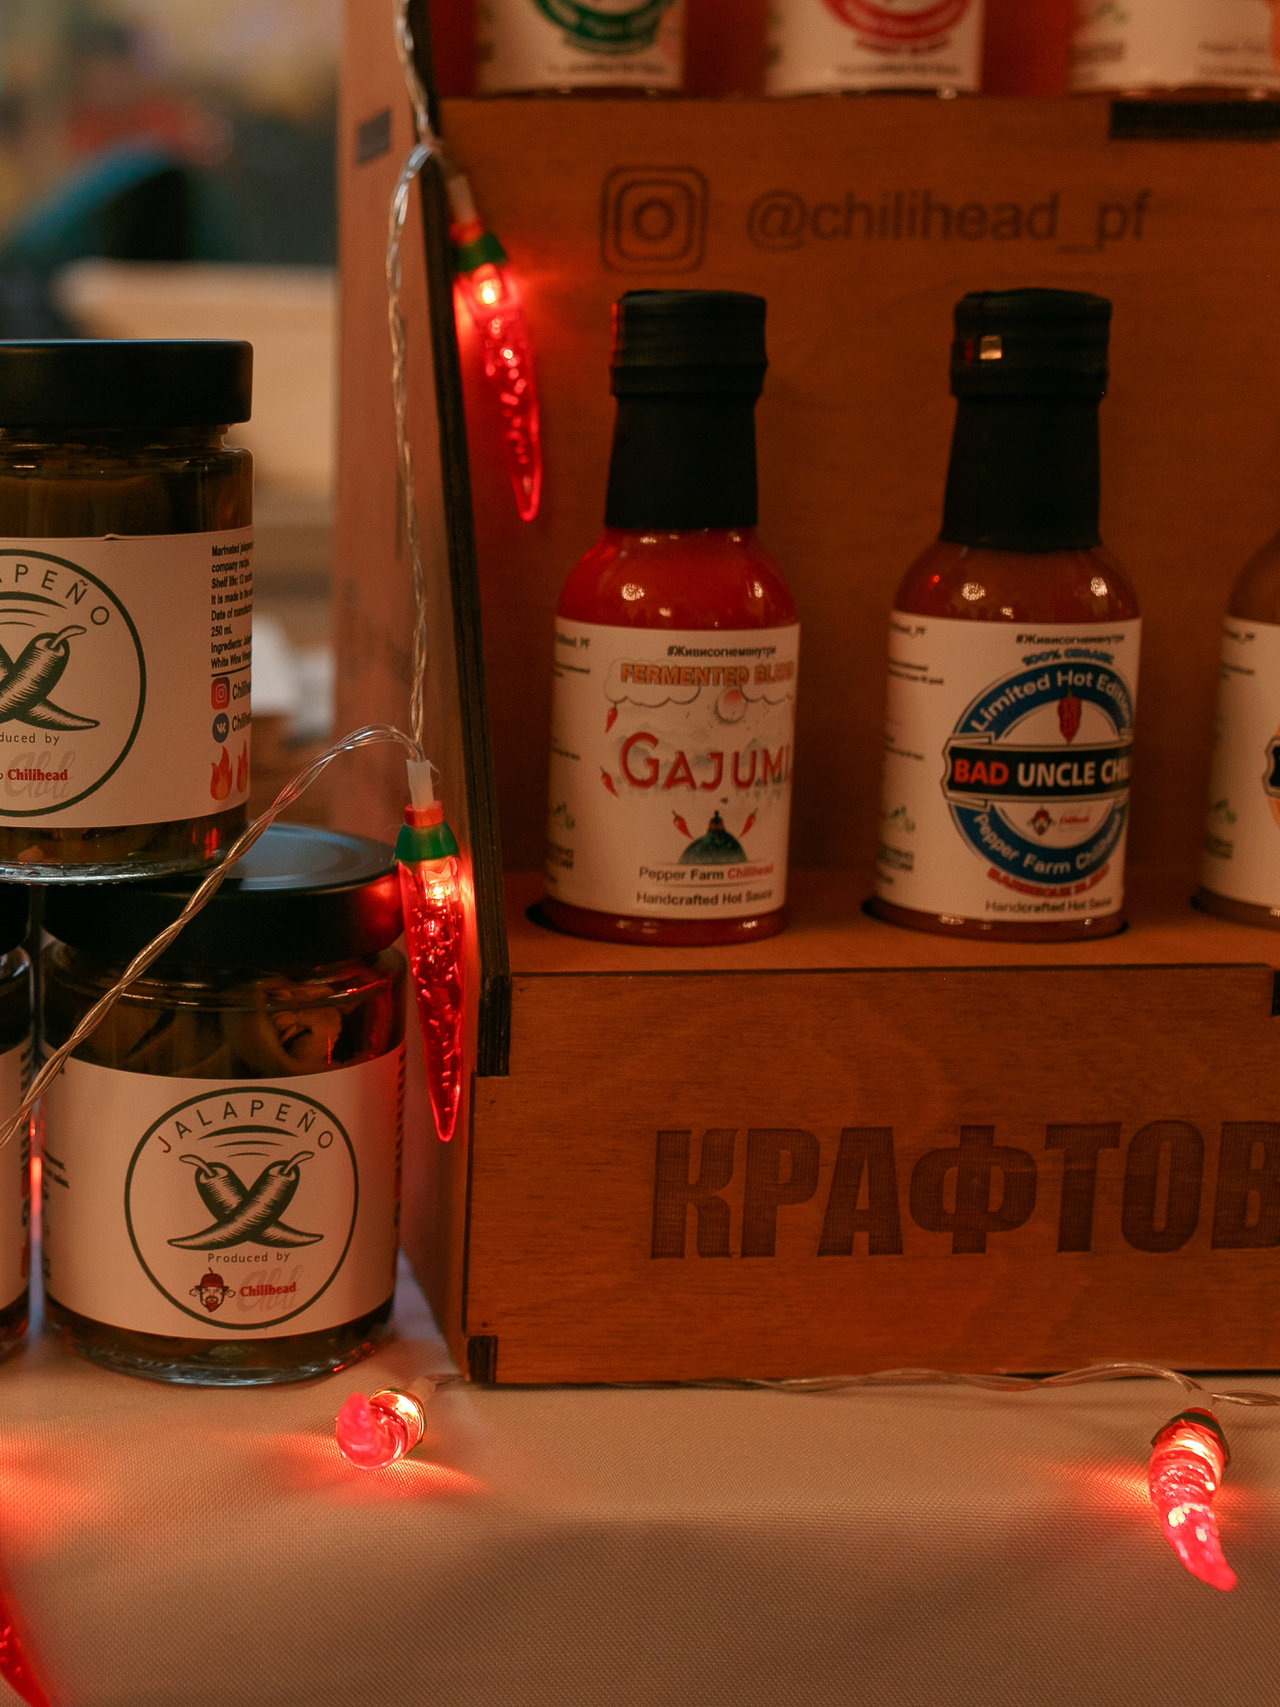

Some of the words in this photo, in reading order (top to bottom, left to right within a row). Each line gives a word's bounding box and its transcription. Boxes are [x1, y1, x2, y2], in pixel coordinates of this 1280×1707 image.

[746, 187, 1152, 255] @chilihead_pf
[212, 561, 237, 573] company
[212, 576, 227, 589] Shelf
[218, 593, 223, 604] is
[211, 610, 225, 622] Date
[227, 606, 233, 619] of
[211, 625, 222, 637] 250
[211, 657, 228, 668] White
[621, 662, 750, 686] FERMENTED
[970, 671, 1051, 733] Limited
[1057, 669, 1093, 688] Hot
[45, 732, 60, 746] by
[7, 768, 68, 781] Chilihead
[954, 758, 1009, 786] BAD
[1017, 760, 1095, 788] UNCLE
[974, 813, 1020, 860] Pepper
[1023, 852, 1070, 875] Farm
[639, 866, 686, 881] Pepper
[690, 868, 724, 880] Farm
[637, 892, 718, 906] Handcrafted
[722, 892, 742, 905] Hot
[985, 900, 1065, 912] Handcrafted
[1068, 900, 1086, 910] Hot
[158, 1099, 334, 1154] JALAPEÑO
[650, 1120, 1280, 1260] КРАФТОВ
[208, 1252, 268, 1263] Produced
[276, 1251, 290, 1262] by
[240, 1281, 297, 1297] Chilihead
